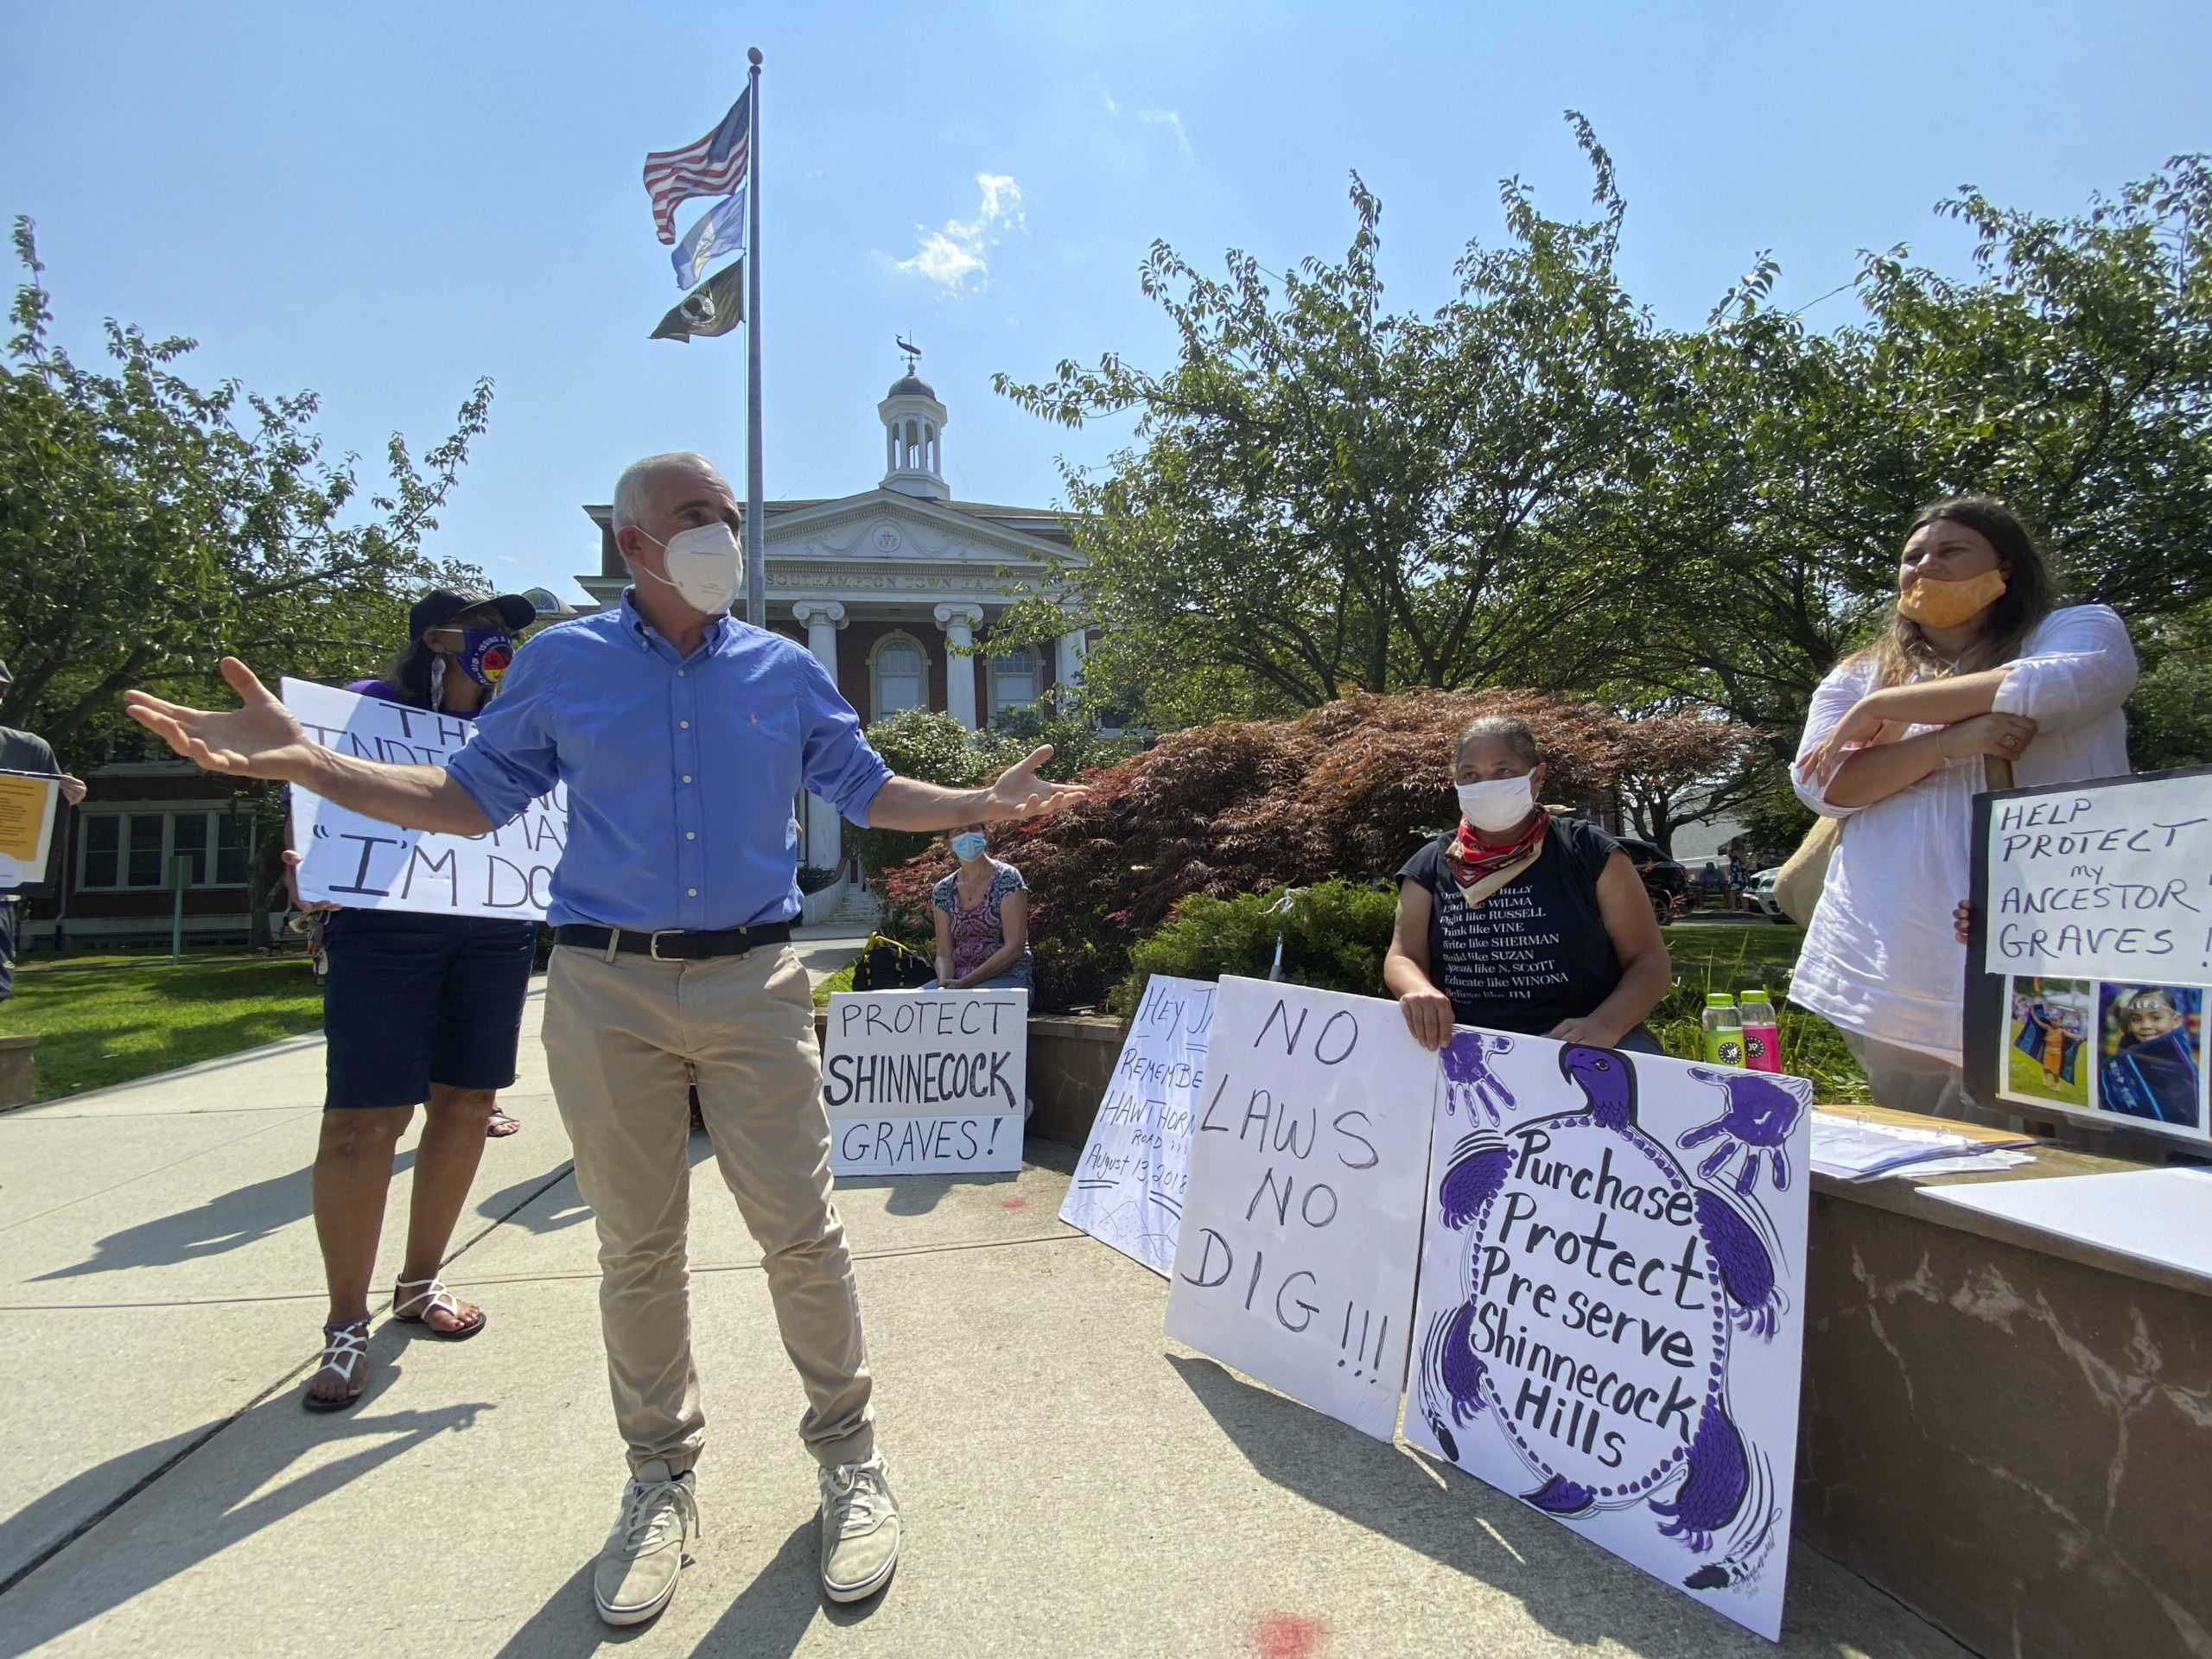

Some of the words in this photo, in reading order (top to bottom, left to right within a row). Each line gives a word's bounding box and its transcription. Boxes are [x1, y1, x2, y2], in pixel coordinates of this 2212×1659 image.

[766, 574, 896, 588] SOUTHAMPTON
[906, 576, 951, 589] TOWN
[962, 578, 1001, 589] HALL
[2000, 798, 2092, 831] HELP
[2002, 817, 2208, 862] PROTECT
[1465, 912, 1485, 921] like
[1489, 907, 1546, 919] RUSSELL
[1488, 897, 1533, 907] WILMA
[1469, 938, 1489, 948] like
[1491, 933, 1560, 947] SHERMAN
[1470, 924, 1491, 934] like
[1493, 922, 1524, 932] VINE
[1446, 962, 1472, 973] Speak
[1474, 963, 1496, 973] like
[1498, 963, 1511, 973] N.
[1512, 959, 1555, 972] SCOTT
[1468, 951, 1489, 961] like
[1491, 950, 1534, 961] SUZAN
[1445, 975, 1484, 987] Educate
[1486, 977, 1510, 987] like
[1511, 972, 1569, 986] WINONA
[842, 1001, 1016, 1037] PROTECT
[1141, 986, 1185, 1042] HEY
[1254, 1000, 1358, 1065] NO
[823, 1051, 1017, 1109] SHINNECOCK
[842, 1117, 1003, 1166] GRAVES!
[1131, 1129, 1162, 1149] ROAD
[1200, 1073, 1379, 1170] LAWS
[1085, 1143, 1130, 1179] August
[1514, 1128, 1694, 1226] Purchase
[1245, 1167, 1338, 1228] NO
[1499, 1192, 1704, 1309] Protect
[1480, 1245, 1695, 1368] Preserve
[1470, 1300, 1697, 1446] Shinnecock
[1514, 1377, 1626, 1468] Hills
